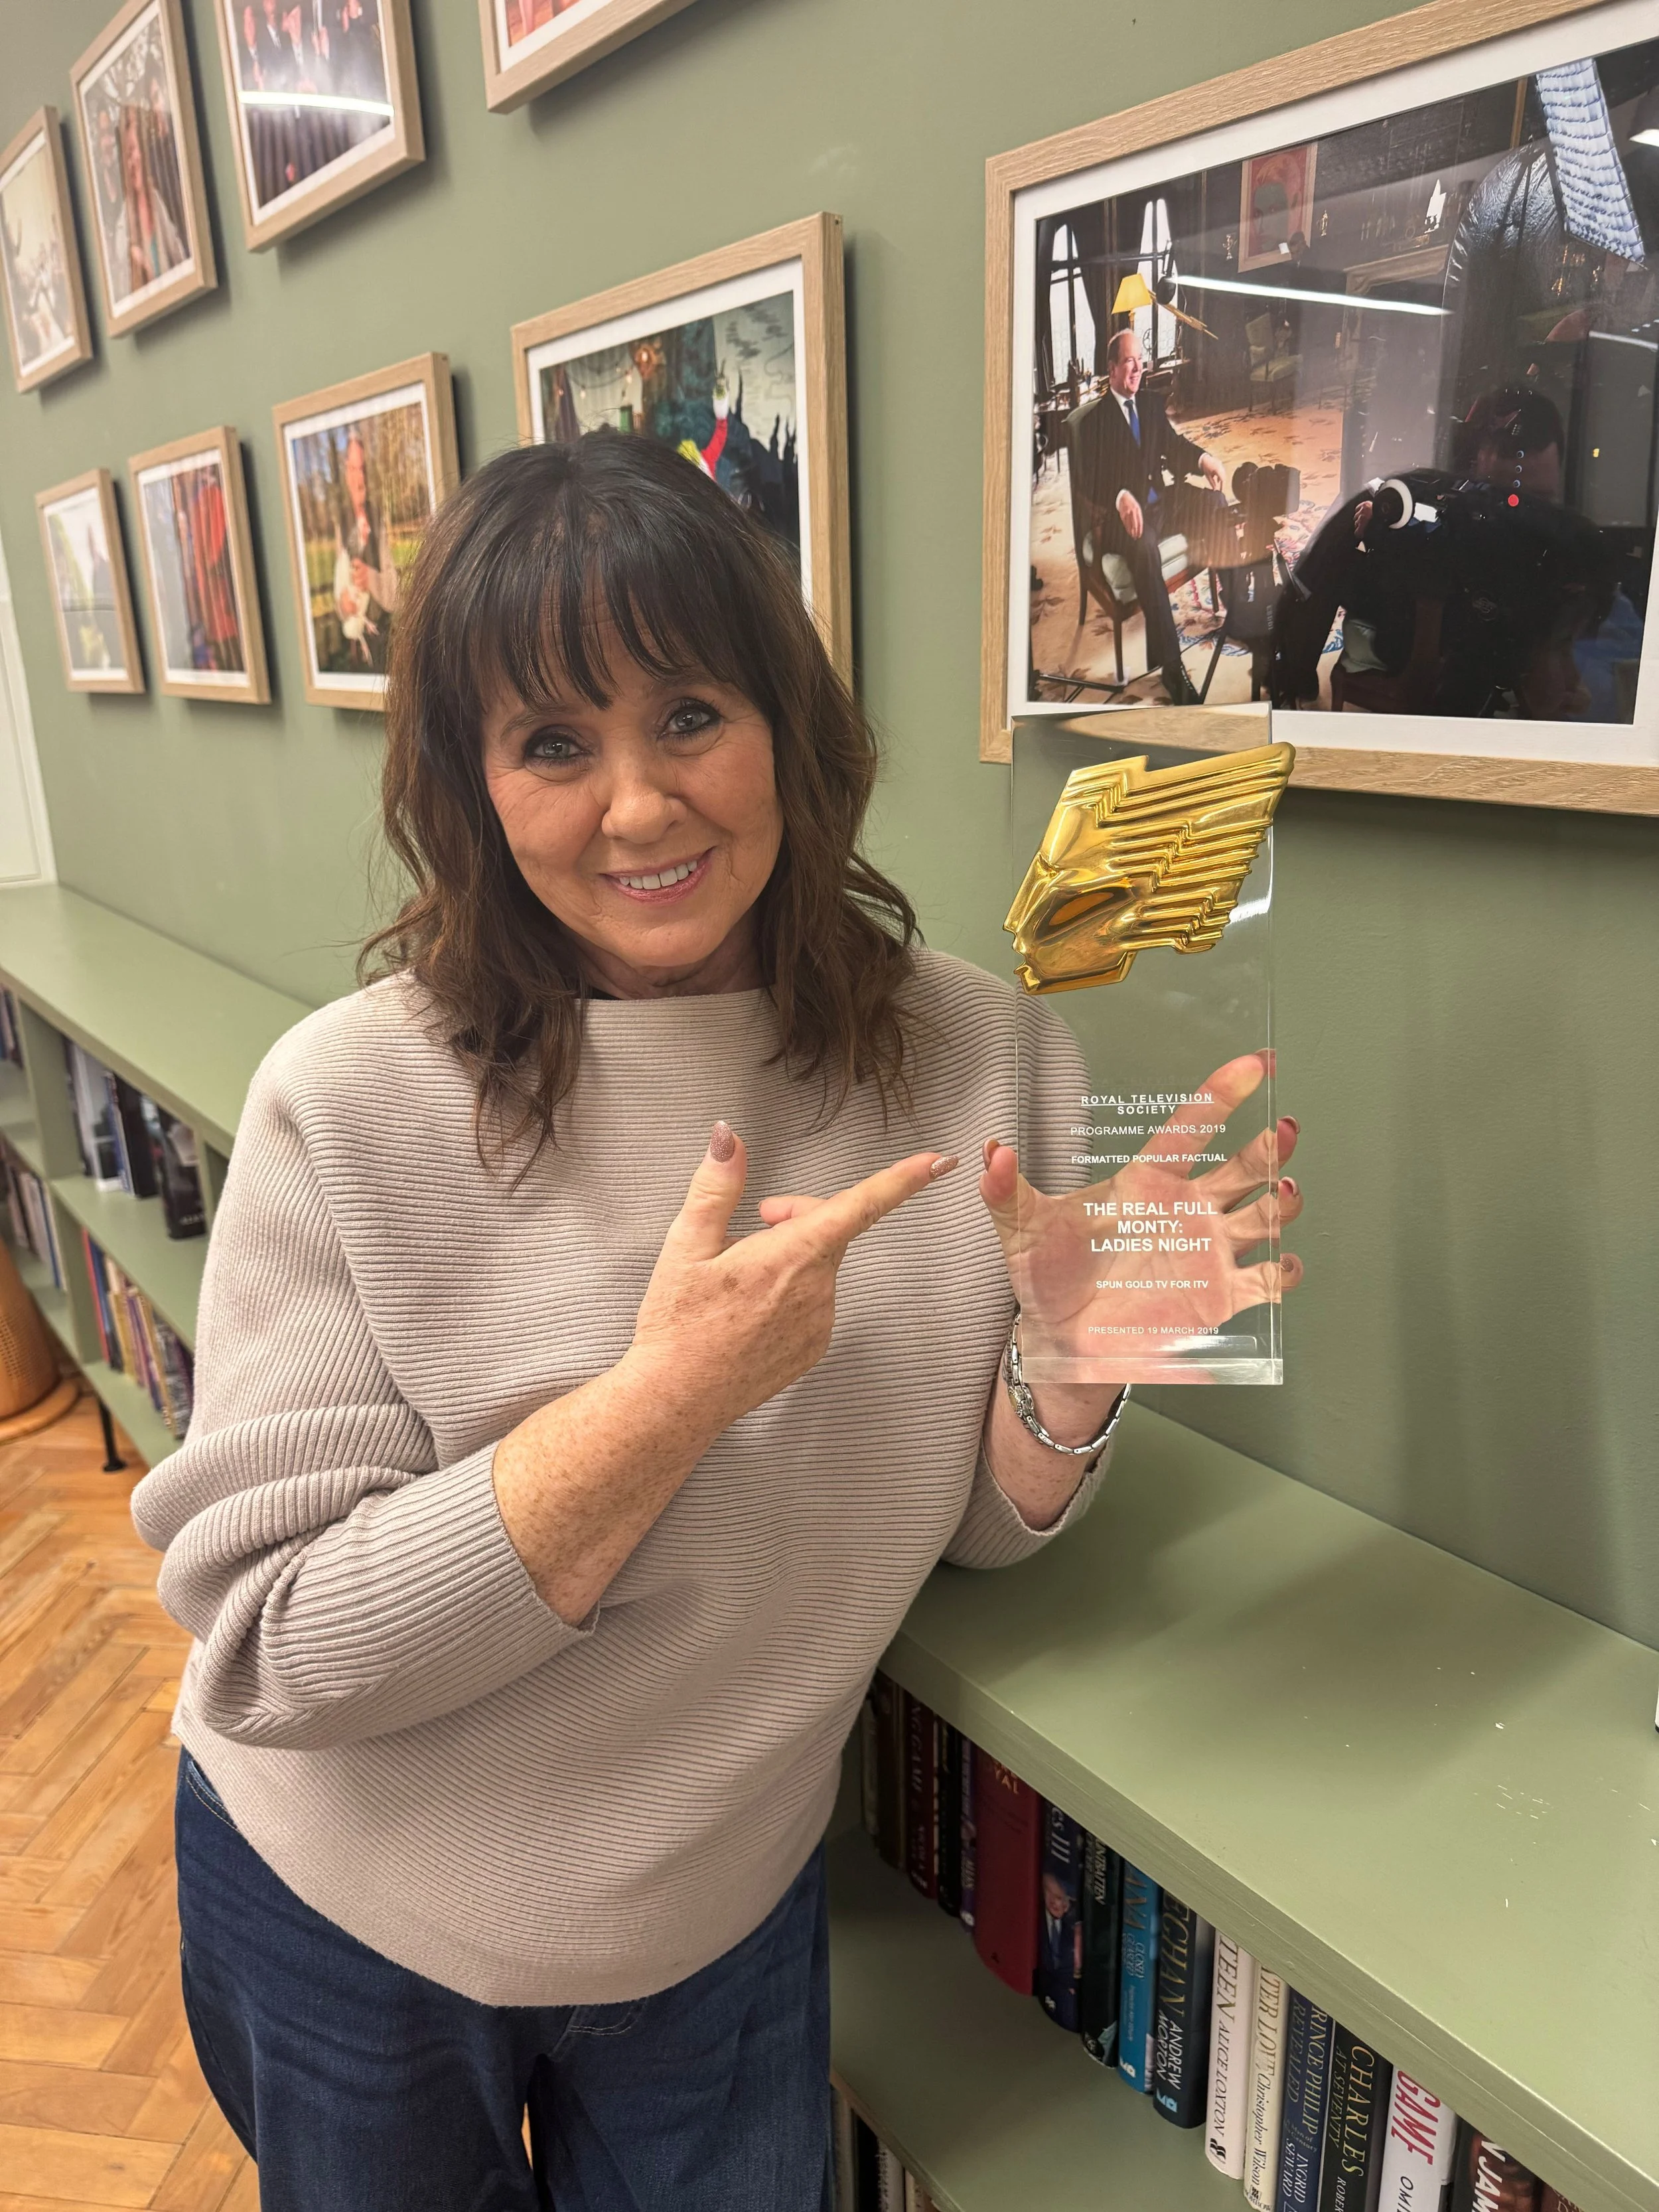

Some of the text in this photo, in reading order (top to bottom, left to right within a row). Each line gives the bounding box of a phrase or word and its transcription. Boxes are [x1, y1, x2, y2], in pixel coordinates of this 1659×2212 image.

[1081, 1093, 1212, 1104] ROYAL TELEVISION
[1117, 1105, 1176, 1114] SOCIETY
[1070, 1124, 1226, 1136] PROGRAMME AWARDS 2019
[1071, 1153, 1228, 1163] FORMATTED POPULAR FACTUAL
[1083, 1201, 1218, 1216] THE REAL FULL
[1118, 1220, 1183, 1234] MONTY:
[1090, 1237, 1212, 1252] LADIES NIGHT
[1096, 1280, 1208, 1289] SPUN GOLD TV FOR ITV
[1197, 1326, 1219, 1335] 2019
[1156, 2011, 1170, 2081] MORTON
[1167, 2020, 1184, 2090] ANDREW
[1216, 2021, 1230, 2068] ALICE
[1287, 1998, 1306, 2103] REVEALED
[1335, 2046, 1347, 2071] AT
[1214, 2069, 1228, 2138] LOXTON
[1253, 2074, 1271, 2144] Christopher
[1301, 2071, 1322, 2136] PHILIP
[1329, 2073, 1345, 2148] SEVENTY
[1340, 2045, 1375, 2177] CHARLES
[1390, 2071, 1441, 2165] GAME
[1252, 2148, 1267, 2187] Wilson
[1281, 2138, 1296, 2197] SEWARD
[1293, 2153, 1309, 2203] INGRID
[1471, 2156, 1504, 2212] JAM
